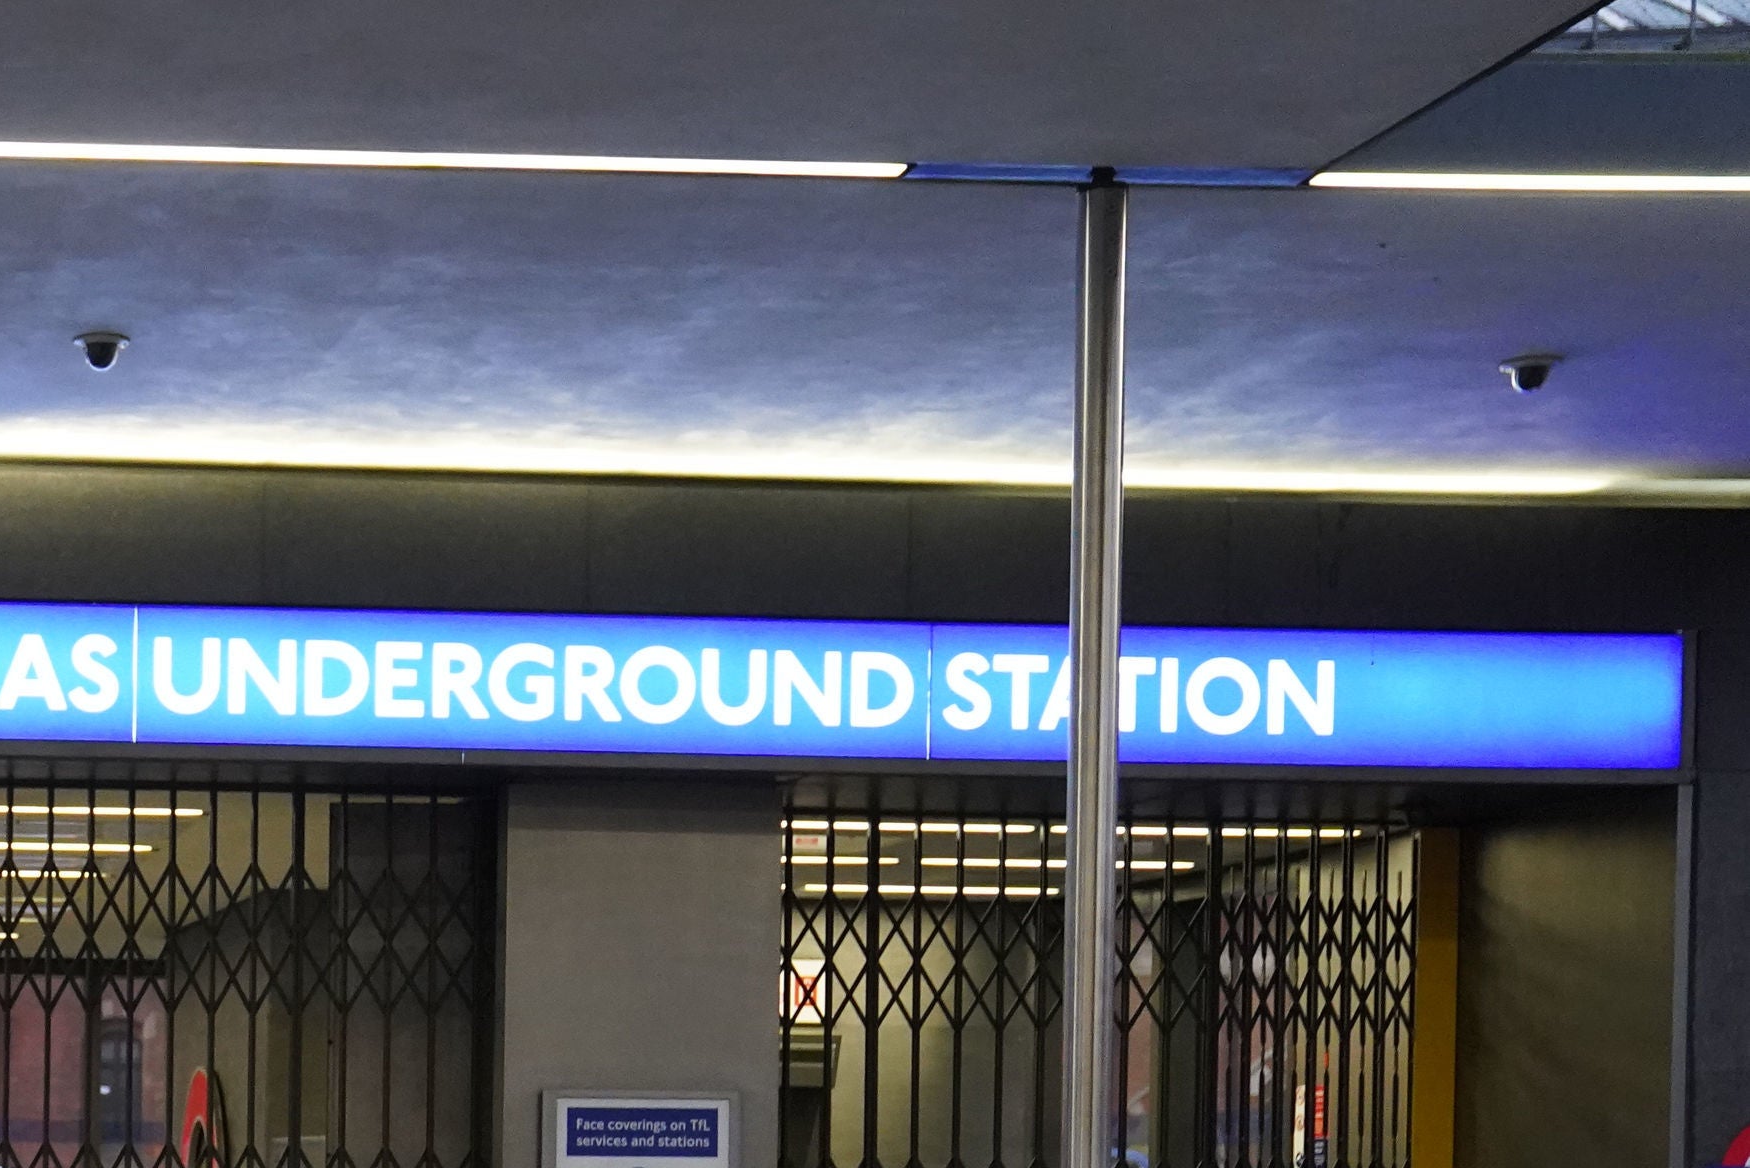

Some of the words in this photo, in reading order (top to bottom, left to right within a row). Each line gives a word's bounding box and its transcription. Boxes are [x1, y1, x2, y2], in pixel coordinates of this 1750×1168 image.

[153, 636, 915, 728] UNDERGROUND
[575, 1118, 604, 1131] Face
[607, 1118, 667, 1134] coverings
[670, 1121, 686, 1131] on
[690, 1118, 711, 1132] TfL
[576, 1135, 628, 1148] services
[631, 1135, 654, 1147] and
[658, 1135, 710, 1148] stations
